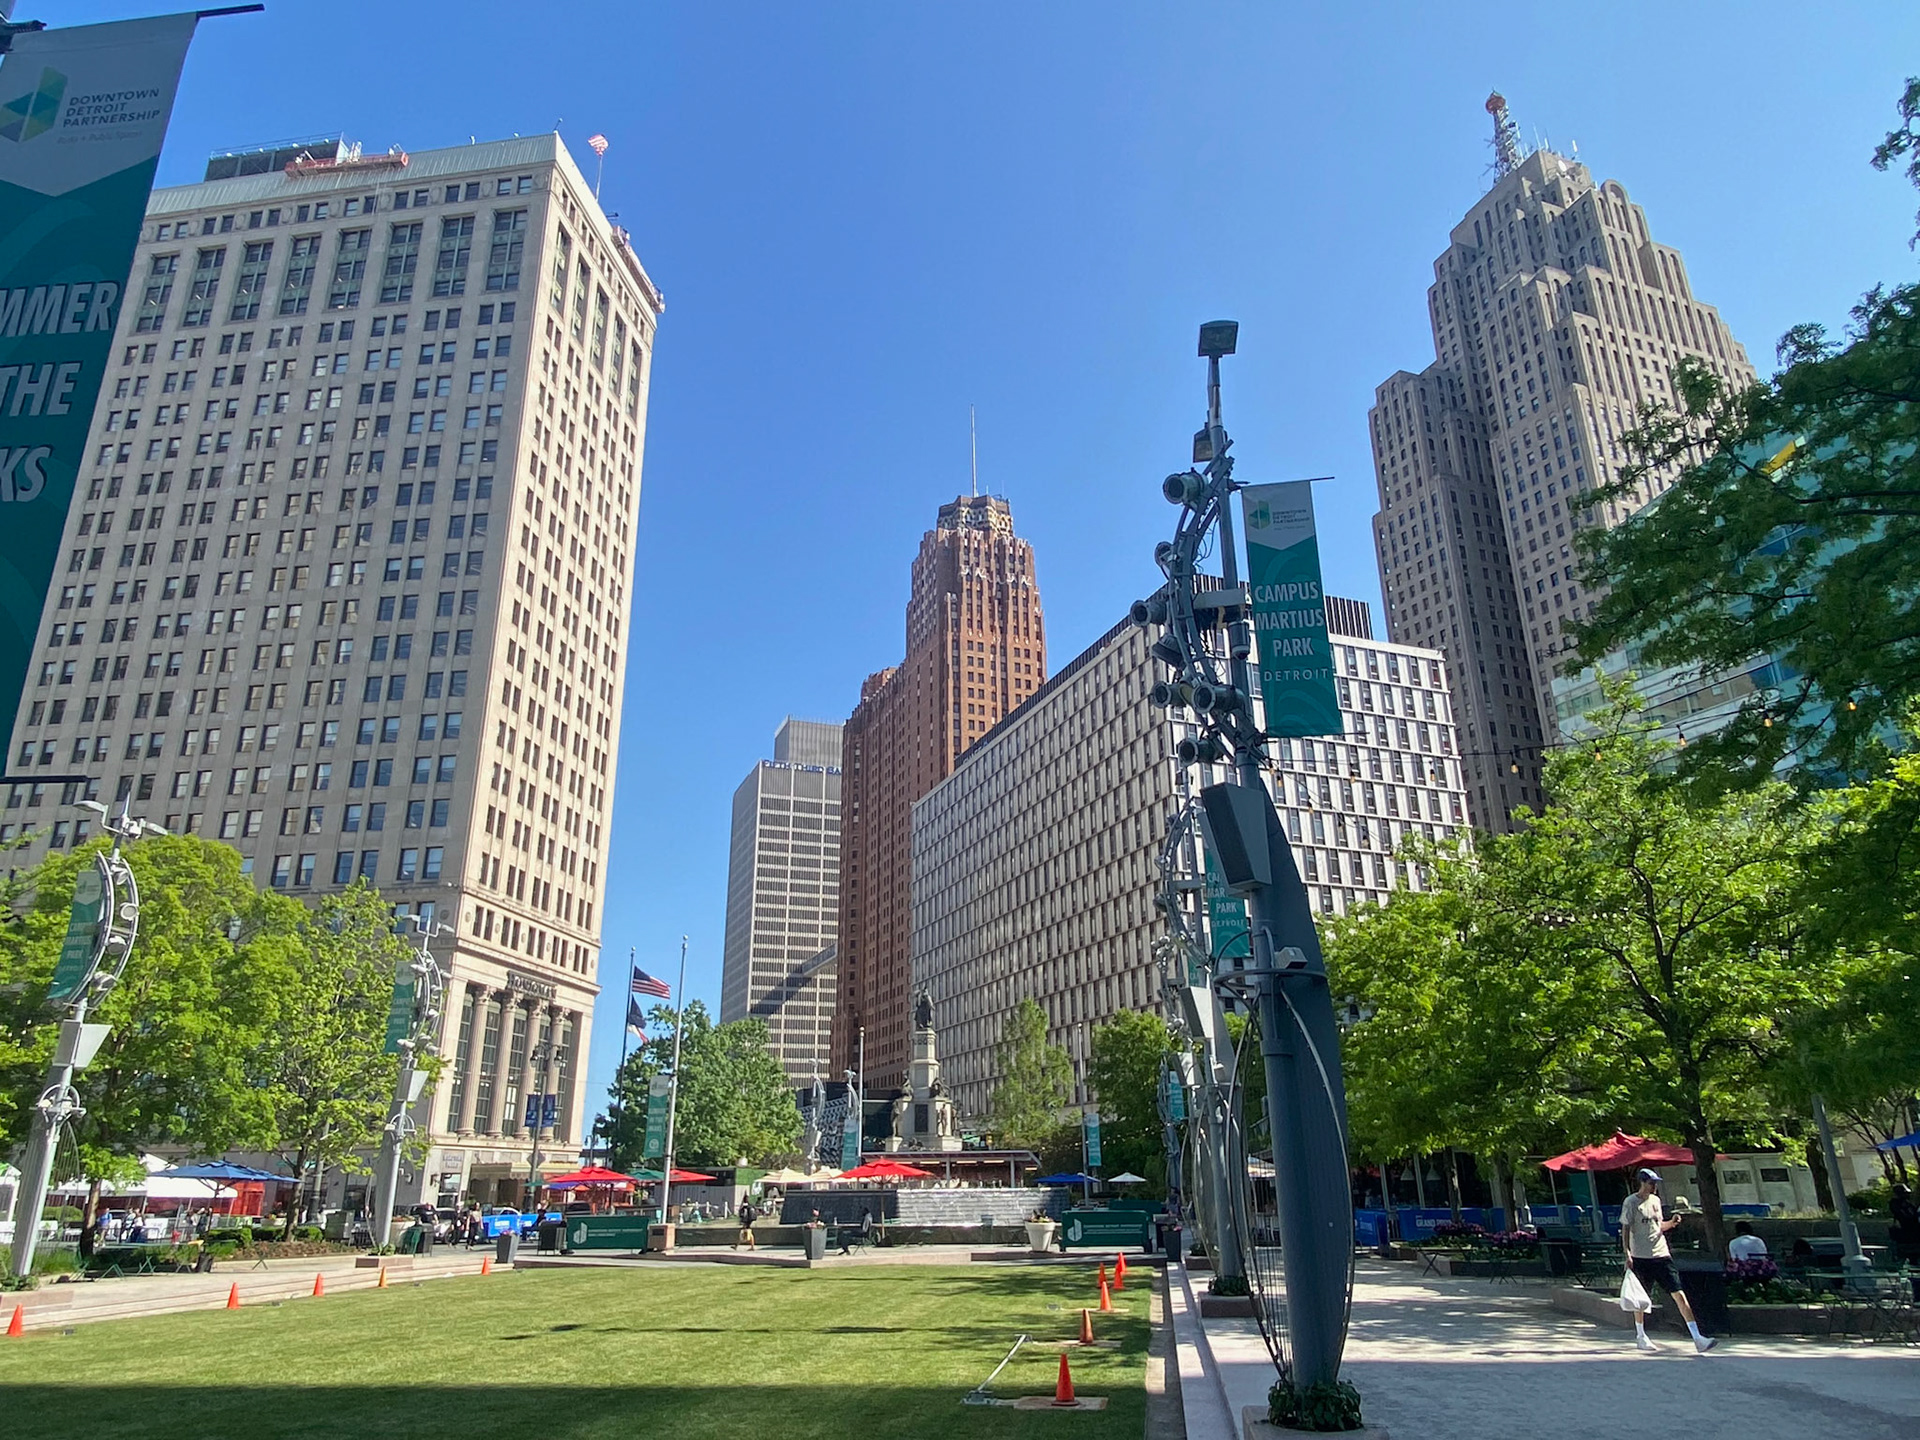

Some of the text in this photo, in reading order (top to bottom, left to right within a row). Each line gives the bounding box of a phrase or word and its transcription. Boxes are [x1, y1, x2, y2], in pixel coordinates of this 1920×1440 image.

[69, 88, 159, 106] DOWNTOWN
[66, 102, 127, 117] DETROIT
[63, 110, 160, 128] PARTNERSHIP
[1254, 582, 1319, 603] CAMPUS
[1255, 608, 1325, 631] MARTIUS
[1273, 637, 1314, 657] PARK
[1264, 668, 1328, 682] DETROIT
[1216, 902, 1237, 914] PARK
[1211, 919, 1244, 928] DETROIT
